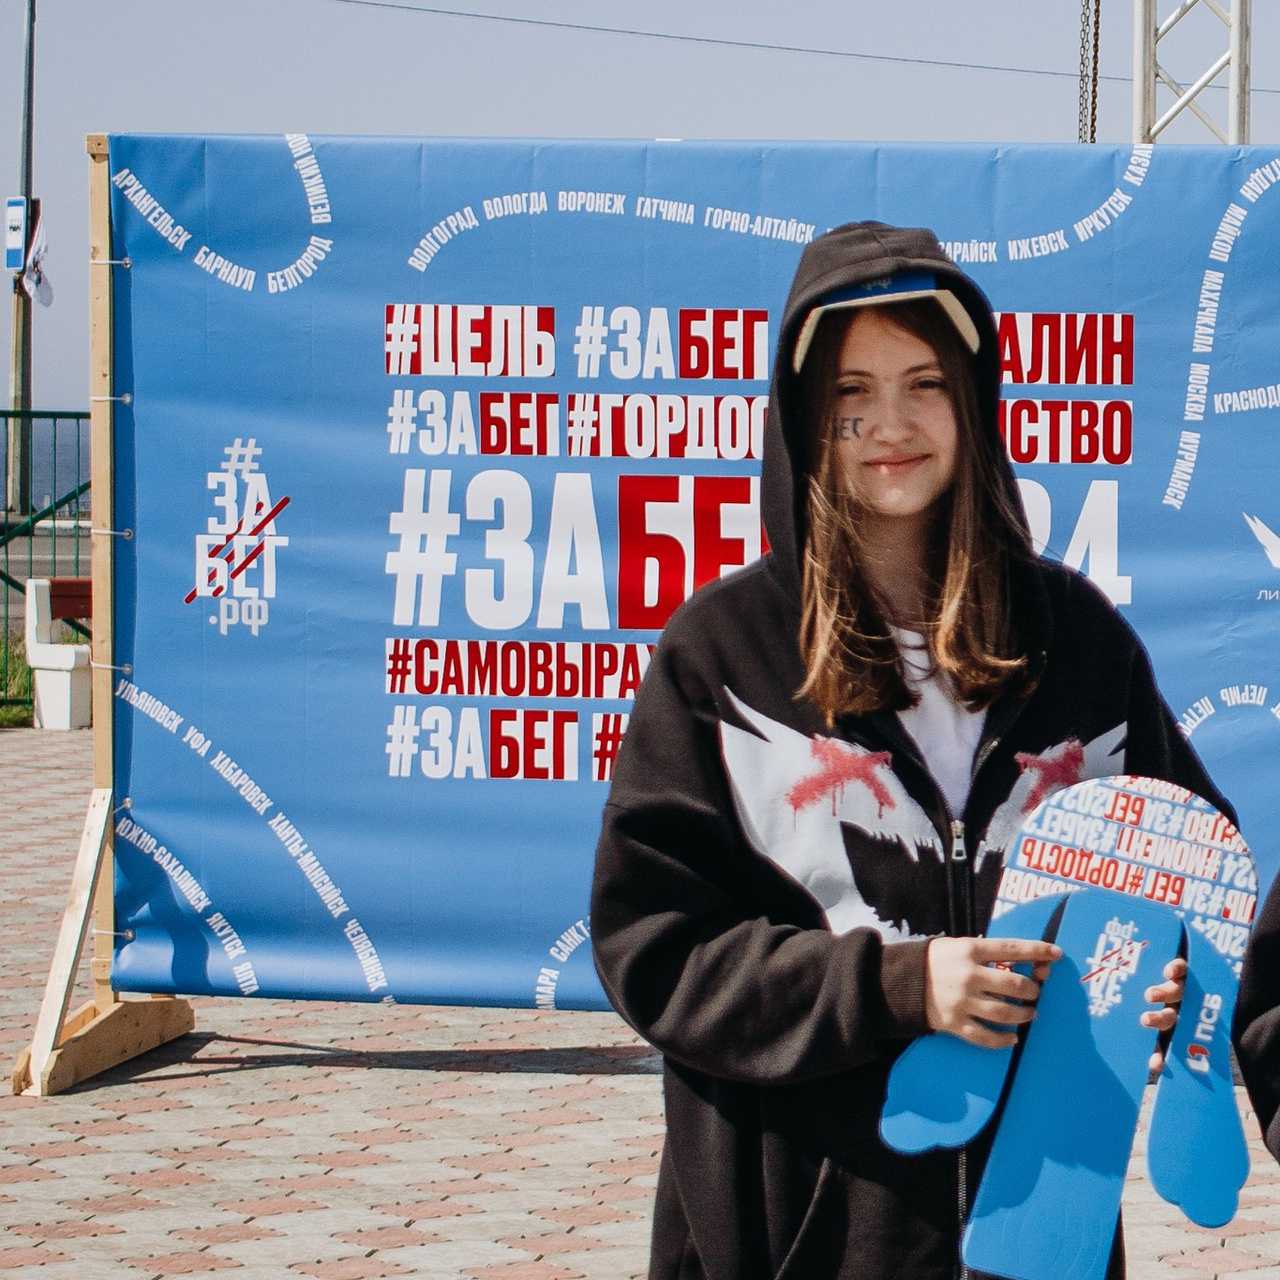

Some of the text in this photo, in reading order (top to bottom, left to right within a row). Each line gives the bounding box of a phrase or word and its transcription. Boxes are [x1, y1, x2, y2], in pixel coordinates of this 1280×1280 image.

[112, 168, 193, 252] АРХАНГЕЛЬСК
[293, 153, 332, 224] ВЕЛИКИЙ
[407, 206, 480, 273] ВОЛГОГРАД
[482, 191, 548, 221] ВОЛОГДА
[557, 190, 627, 215] ВОРОНЕЖ
[635, 197, 695, 225] ГАТЧИНА
[703, 207, 817, 244] ГОРНО-АЛТАЙСК
[1007, 229, 1070, 261] ИЖЕВСК
[1073, 187, 1133, 242] ИРКУТСК
[1208, 202, 1248, 263] МАЙКОП
[193, 245, 257, 292] БАРНАУЛ
[267, 235, 334, 294] БЕЛГОРОД
[1192, 269, 1225, 353] МАХАЧКАЛА
[385, 303, 1135, 385] #ЦЕЛЬ #ЗАБЕГ АЛИН
[1183, 362, 1211, 421] МОСКВА
[387, 389, 560, 456] #ЗАБЕГ
[998, 399, 1134, 465] СТВО
[1161, 430, 1201, 511] МУРМАНСК
[207, 471, 277, 536] ЗА
[195, 534, 290, 599] БЕГ
[385, 468, 768, 631] #ЗАБЕ
[387, 638, 658, 699] #САМОВЫРА
[1219, 684, 1268, 707] ПЕРМЬ
[385, 705, 579, 781] #ЗАБЕГ
[115, 678, 388, 993] УЛЬЯНОВСК УФА ХАБАРОВСК ХАНТЫ-МАНСИЙСК ЧЕЛЯБИНСК
[1020, 836, 1146, 897] #ГОРДОСТЬ
[1115, 825, 1223, 882] #МОМЕНТ
[115, 817, 260, 996] ЮЖНО-САХАЛИНСК ЯКУТСК ЯЛТА
[1142, 869, 1226, 918] #ЗАБЕГ
[1086, 932, 1143, 976] БЕГ
[1088, 966, 1130, 1005] ЗА
[1194, 992, 1223, 1043] ПСБ
